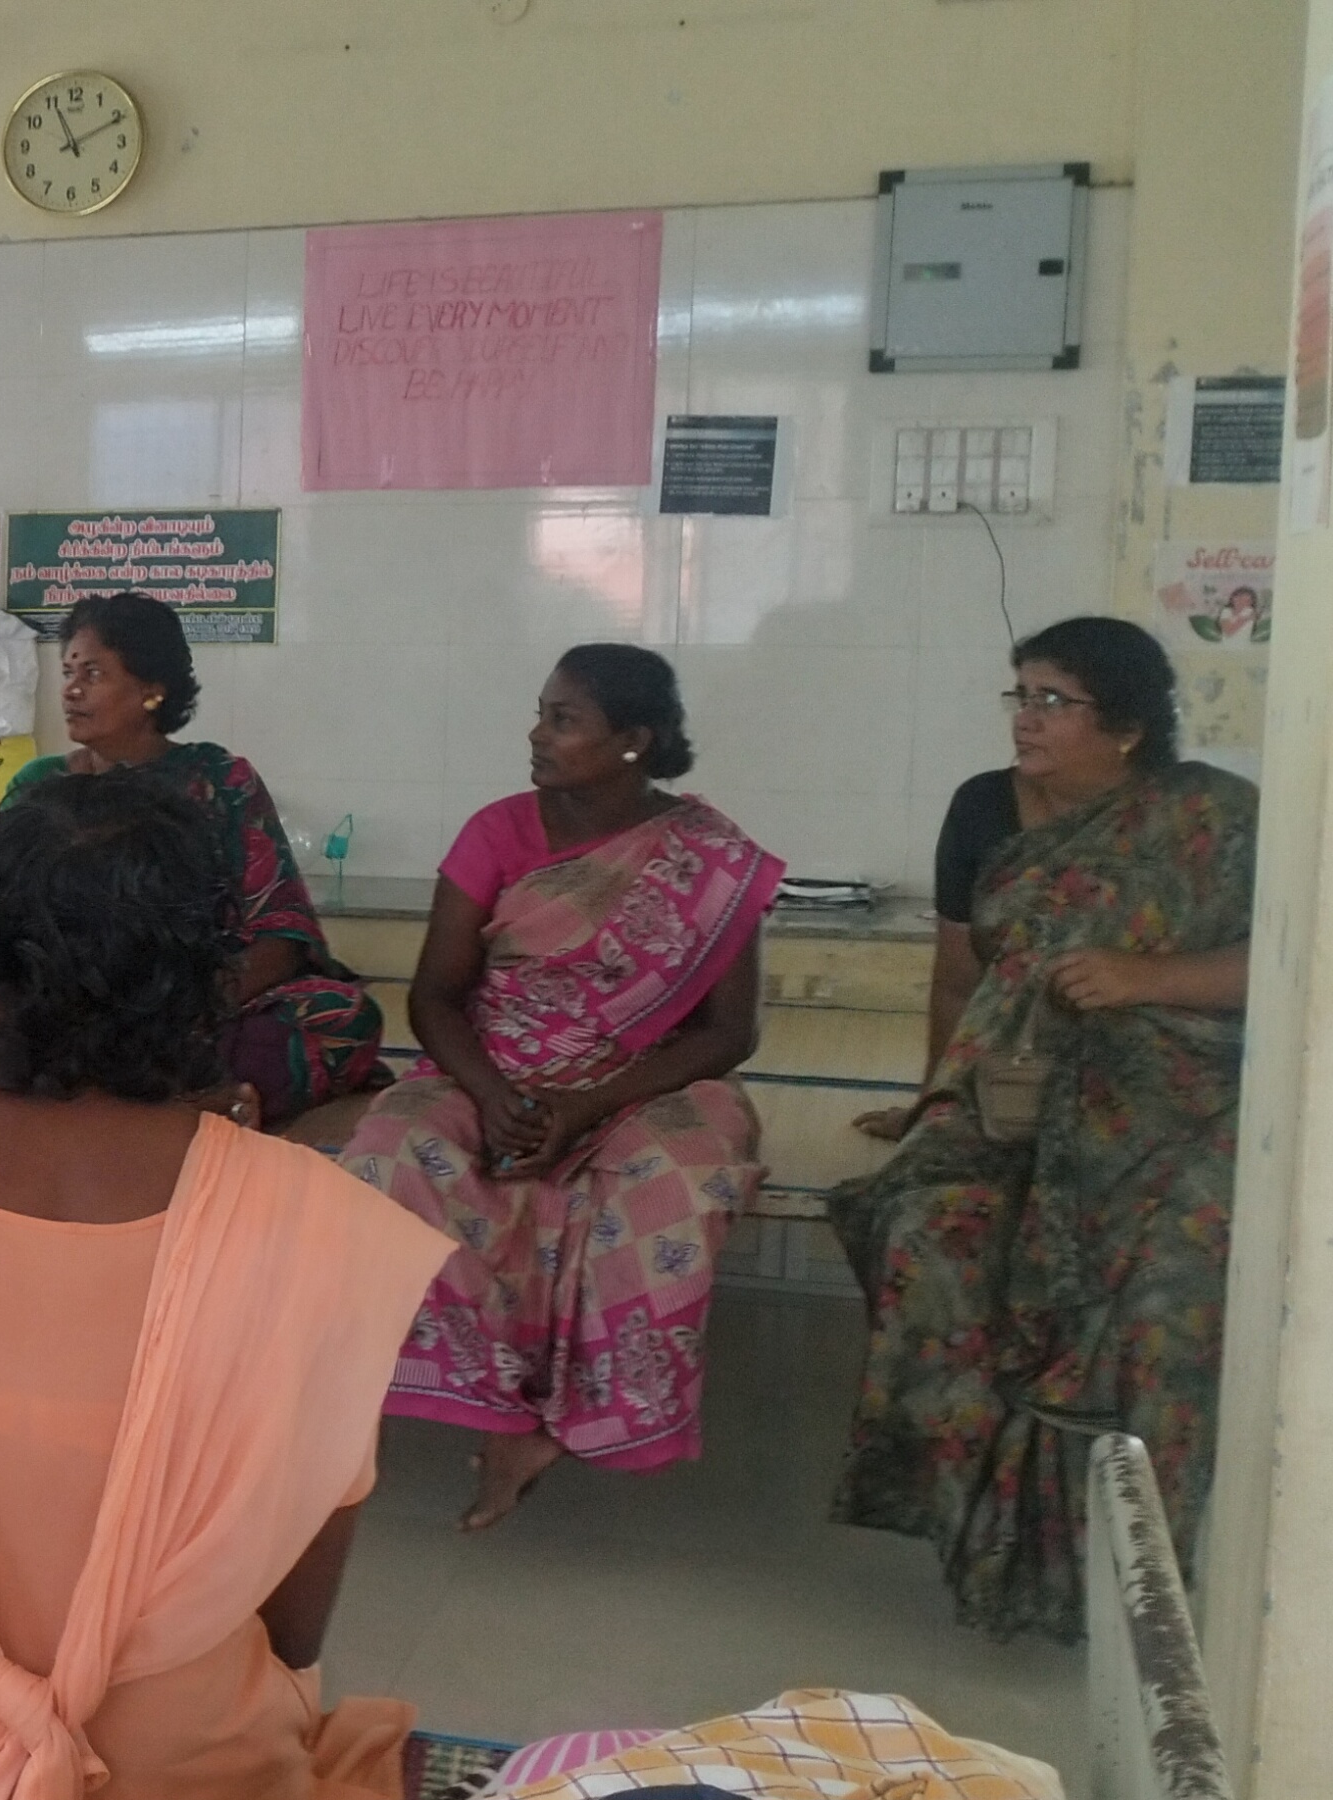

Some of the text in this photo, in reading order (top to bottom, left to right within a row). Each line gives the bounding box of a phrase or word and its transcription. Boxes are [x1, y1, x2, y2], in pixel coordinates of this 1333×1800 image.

[68, 87, 83, 101] 12
[96, 92, 104, 107] 1
[45, 97, 59, 109] 11
[27, 115, 42, 129] 10
[111, 109, 123, 123] 2
[20, 139, 30, 154] 9
[117, 134, 126, 149] 3
[25, 163, 36, 178] 8
[109, 160, 119, 174] 4
[42, 180, 52, 196] 7
[90, 178, 100, 193] 5
[66, 186, 76, 201] 6
[338, 296, 615, 334] LIVE EVERY MOMENT
